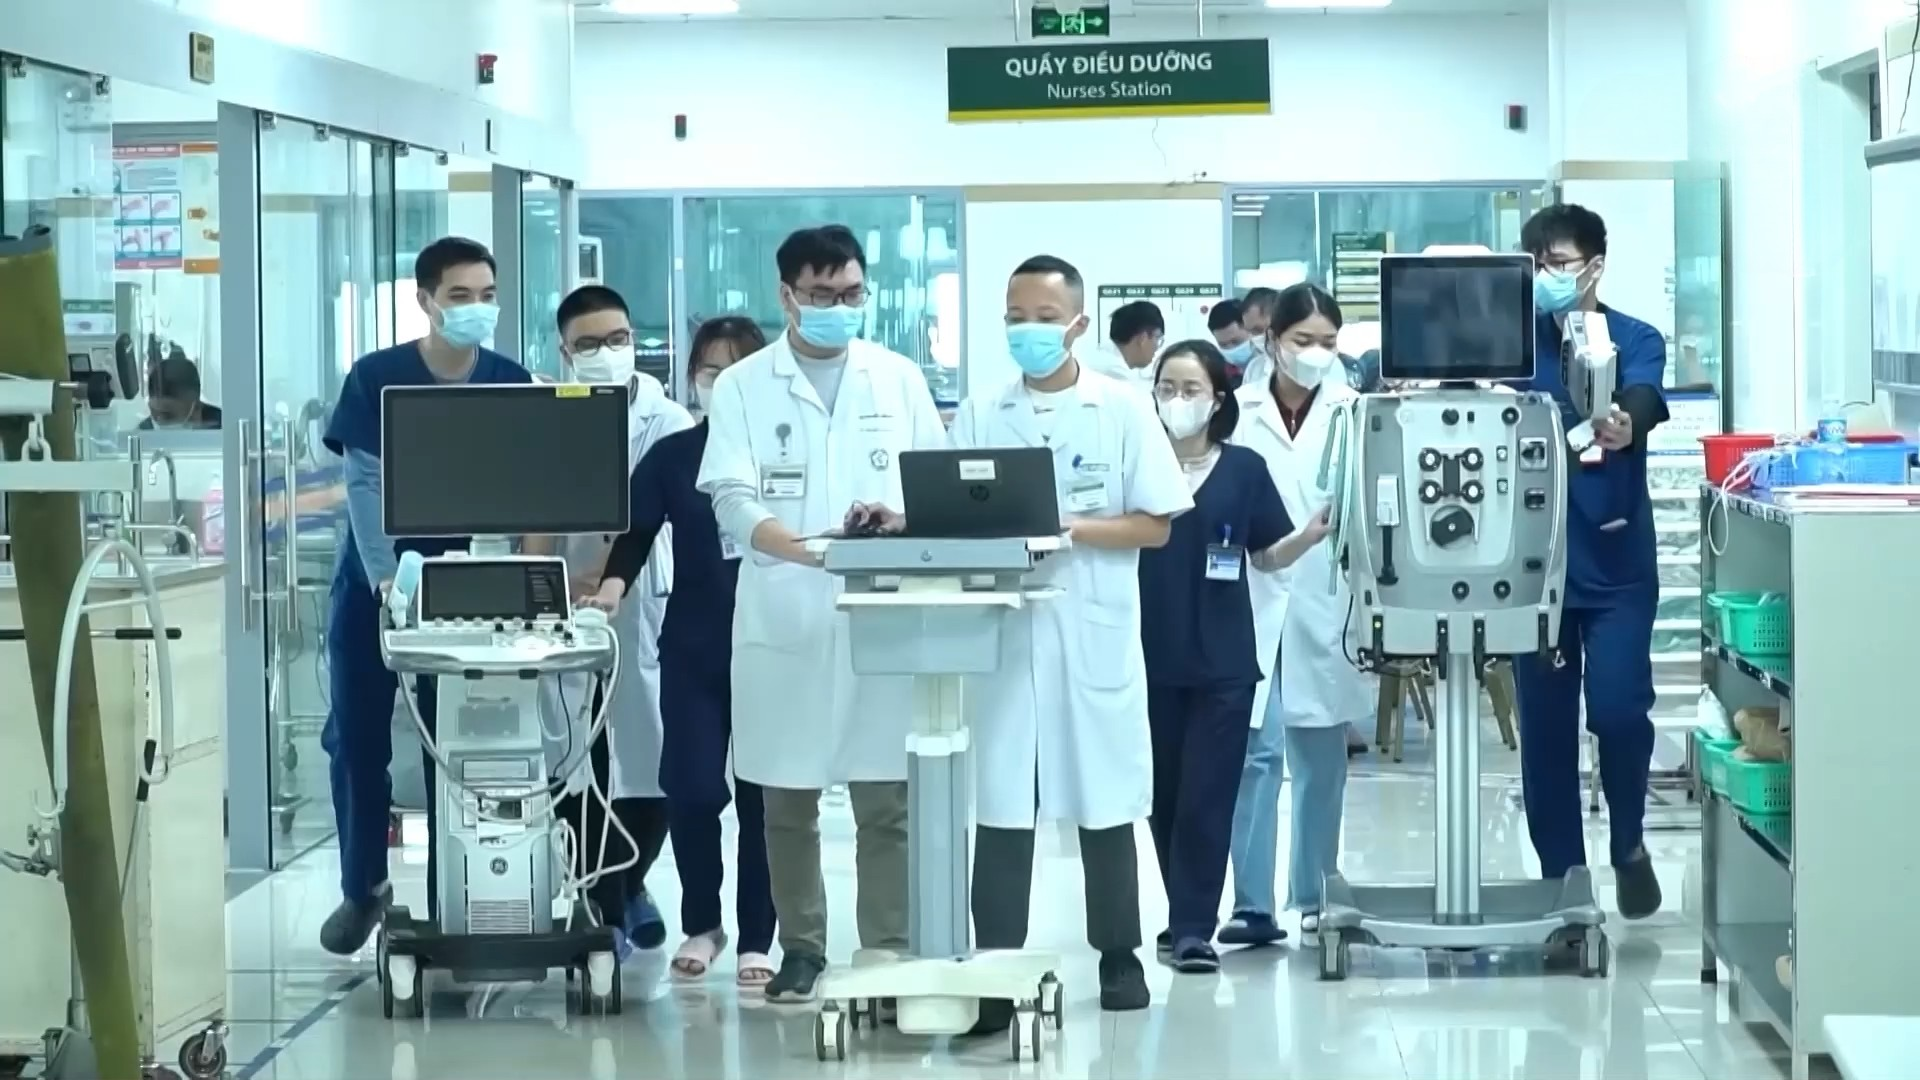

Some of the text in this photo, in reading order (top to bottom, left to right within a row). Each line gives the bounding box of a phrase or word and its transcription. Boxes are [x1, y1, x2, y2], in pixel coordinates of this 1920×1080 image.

[1130, 49, 1212, 73] DƯỠNG
[1047, 80, 1172, 99] Nurses Station
